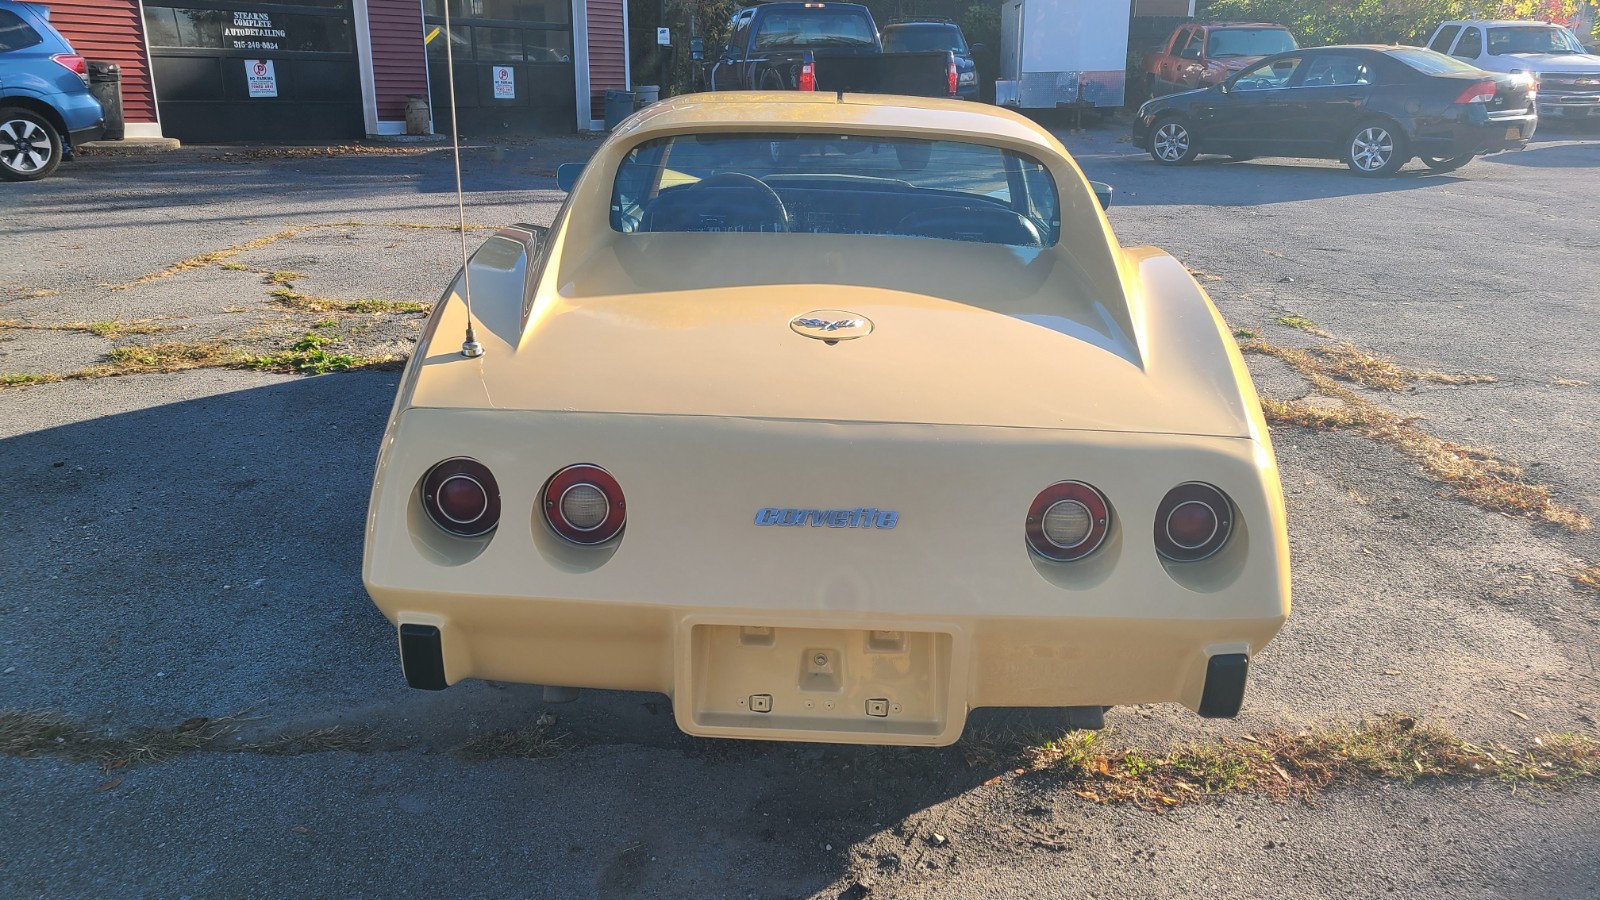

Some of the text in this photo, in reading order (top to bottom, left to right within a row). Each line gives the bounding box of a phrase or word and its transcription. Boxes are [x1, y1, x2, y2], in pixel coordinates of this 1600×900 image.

[233, 11, 269, 20] STEARNS
[233, 19, 272, 28] COMPLETE
[754, 506, 900, 530] Corvette
